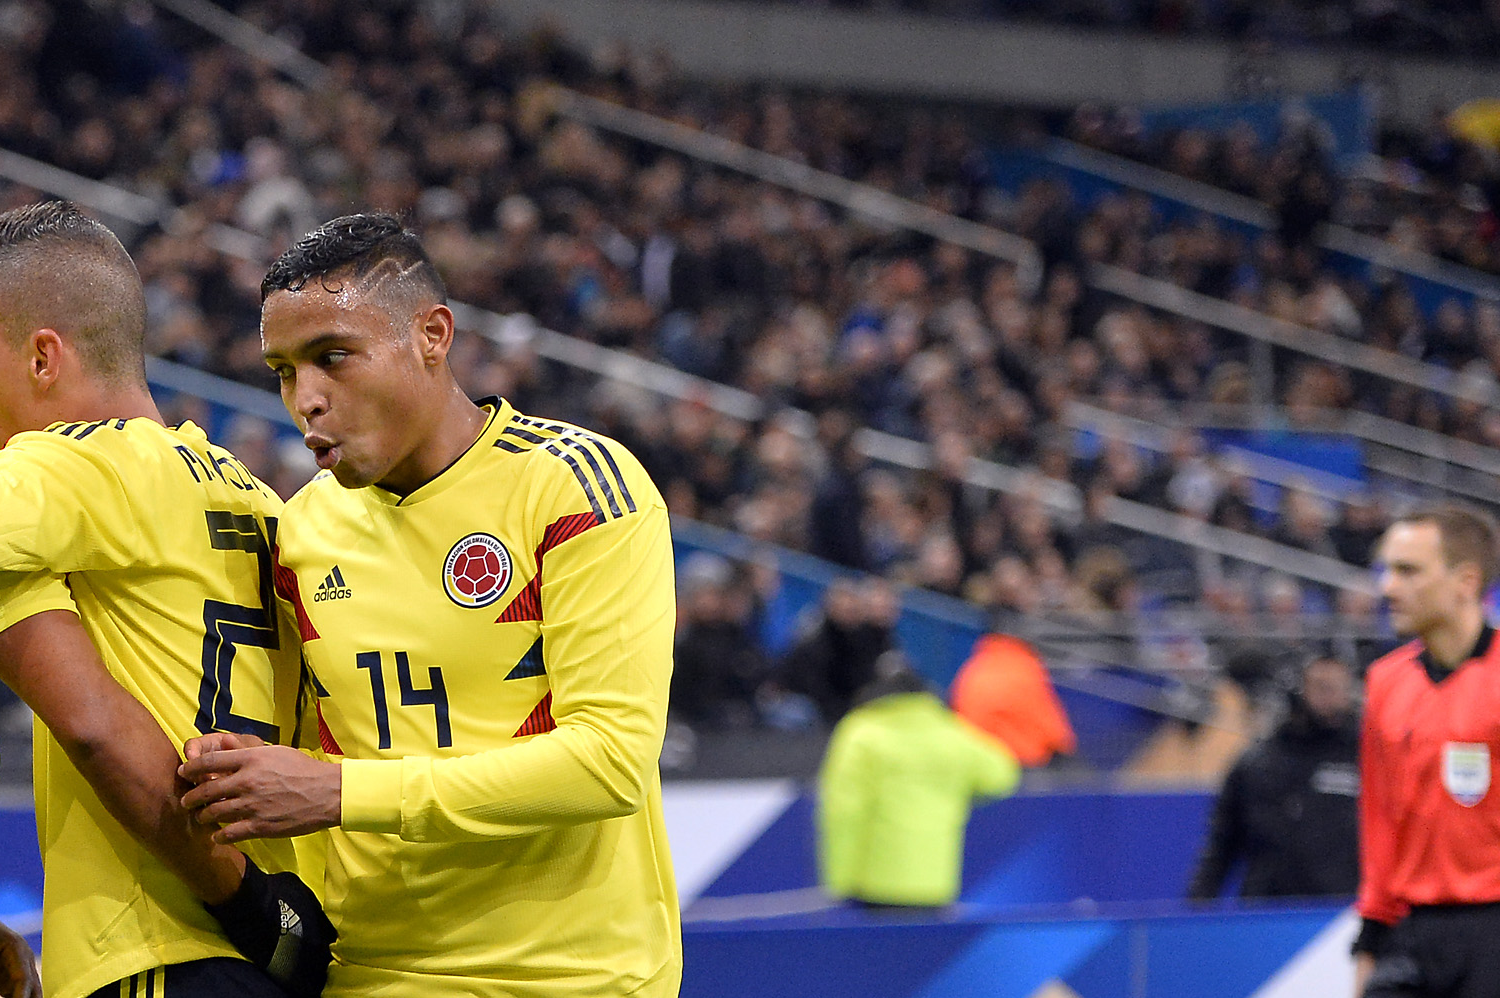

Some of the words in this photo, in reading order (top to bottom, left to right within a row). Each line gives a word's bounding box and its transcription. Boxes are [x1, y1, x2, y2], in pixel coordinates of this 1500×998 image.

[194, 509, 280, 746] 2
[313, 587, 352, 603] adidas
[355, 650, 453, 750] 14
